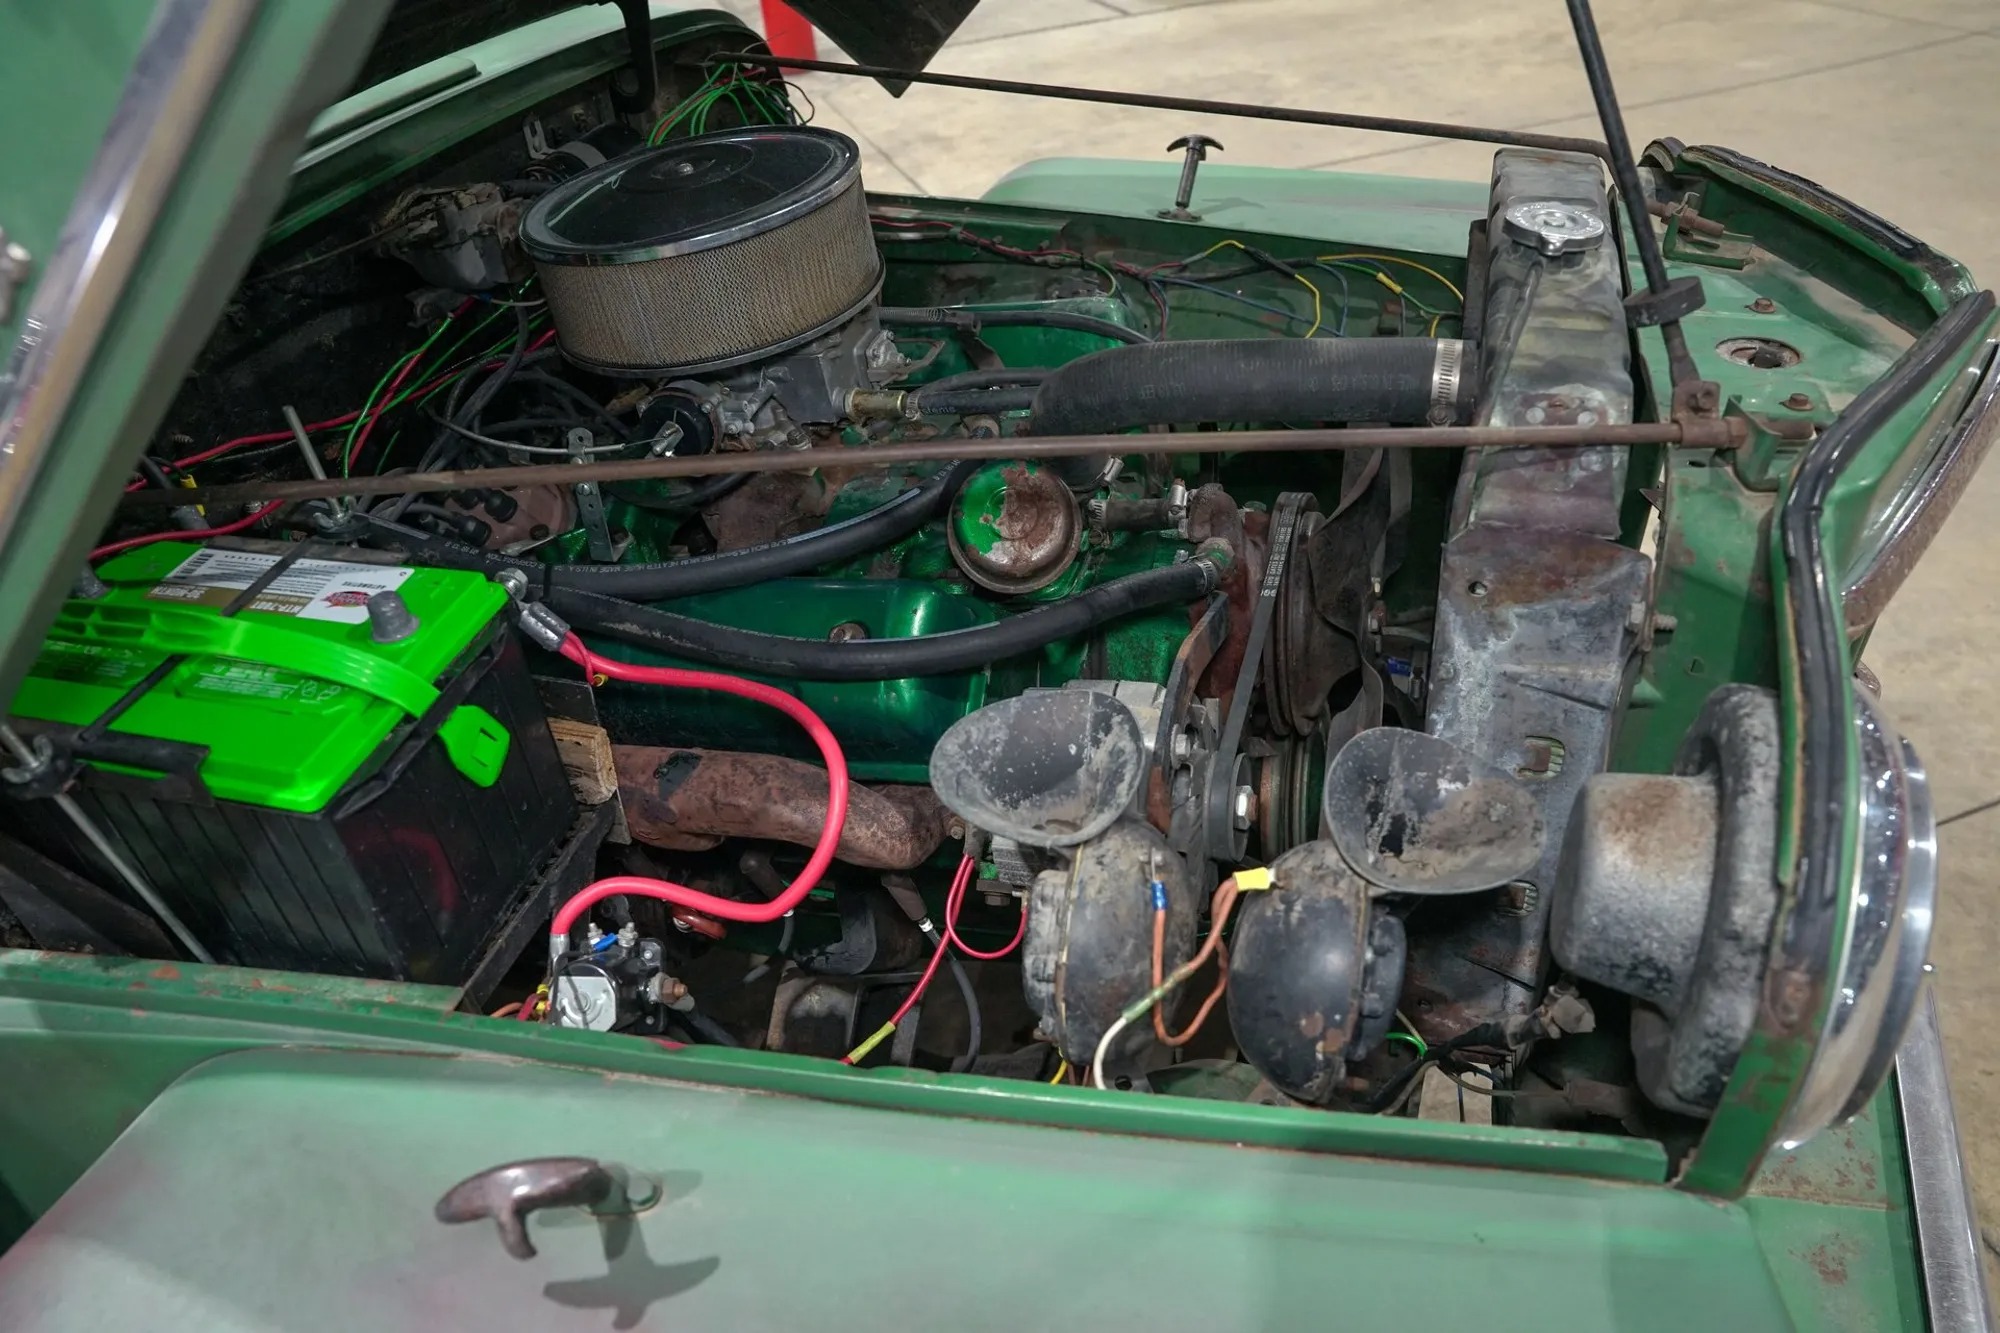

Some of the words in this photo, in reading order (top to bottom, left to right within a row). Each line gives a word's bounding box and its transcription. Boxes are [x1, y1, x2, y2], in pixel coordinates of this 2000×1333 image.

[485, 552, 537, 568] CORPORATION
[680, 554, 715, 566] PREMIUM
[599, 565, 620, 573] MADE
[646, 561, 678, 570] HEATER
